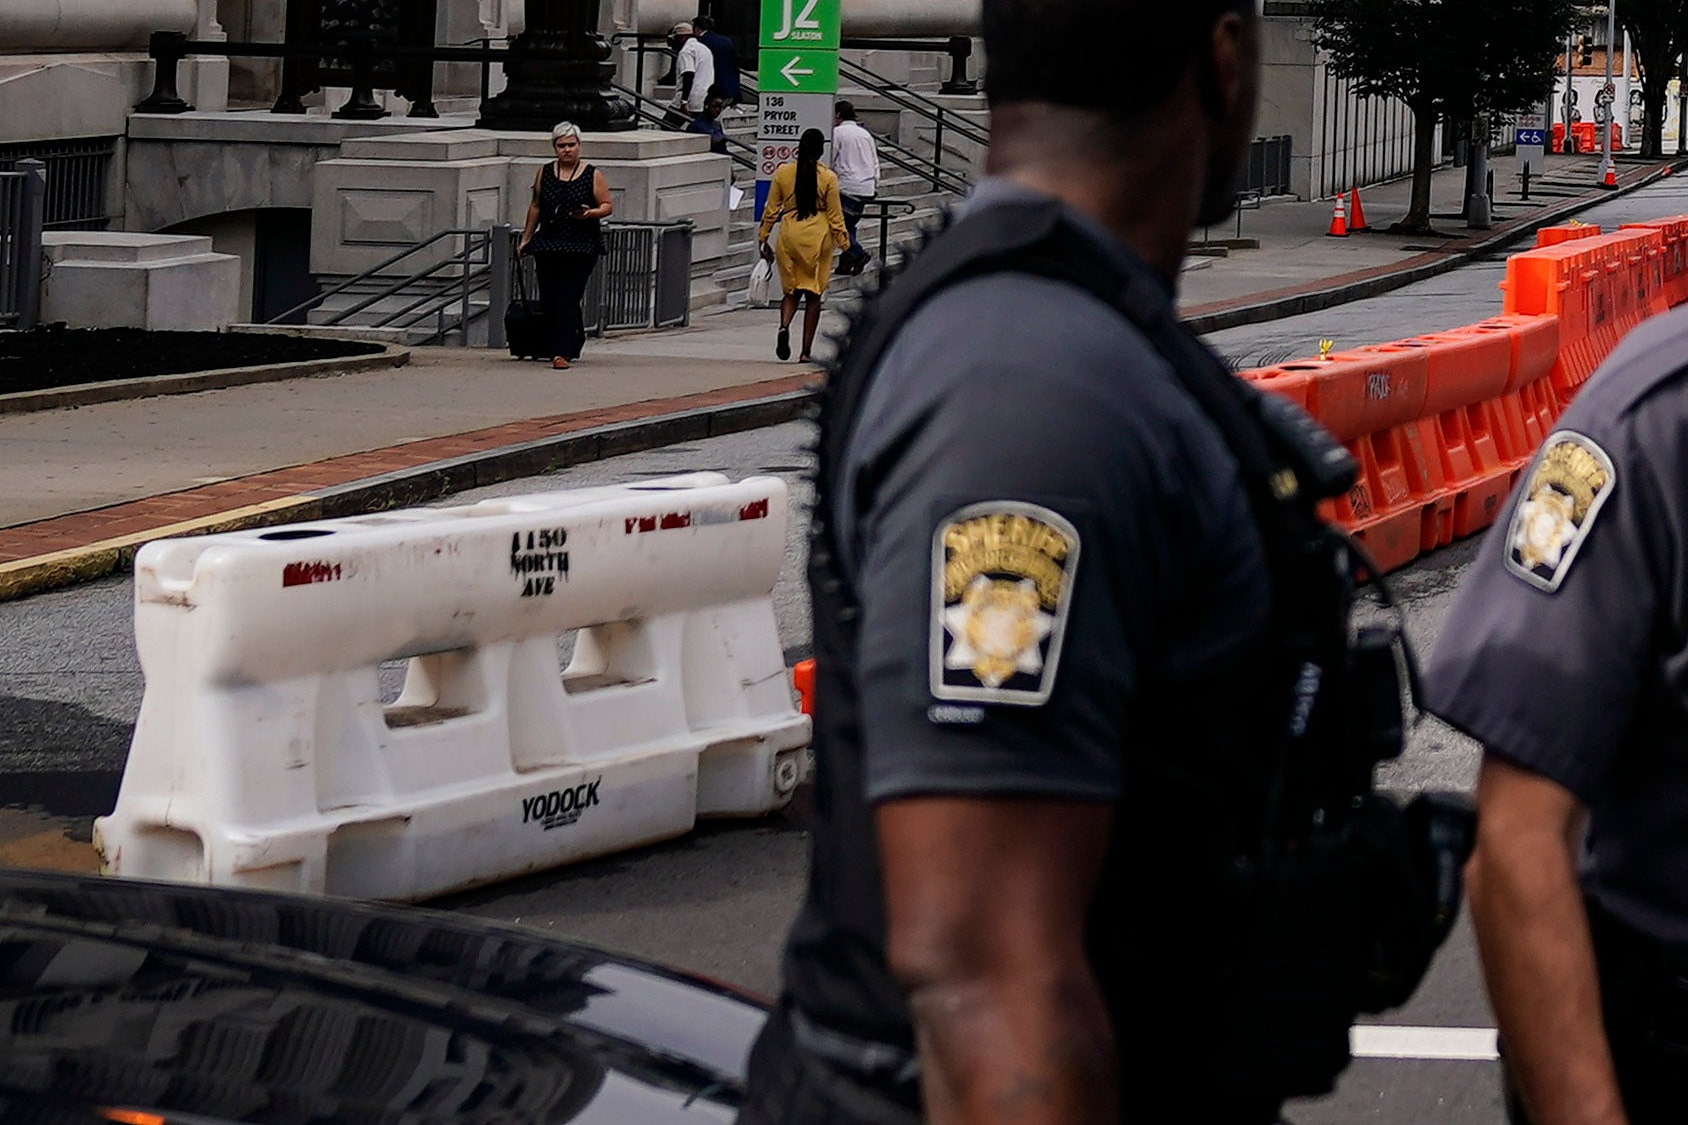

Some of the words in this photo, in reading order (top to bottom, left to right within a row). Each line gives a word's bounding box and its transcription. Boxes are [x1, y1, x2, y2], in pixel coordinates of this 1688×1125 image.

[764, 110, 797, 121] PRYOR
[763, 124, 801, 135] STREET
[510, 550, 569, 574] NORTH
[521, 576, 556, 597] AVE
[522, 773, 602, 824] YODOCK
